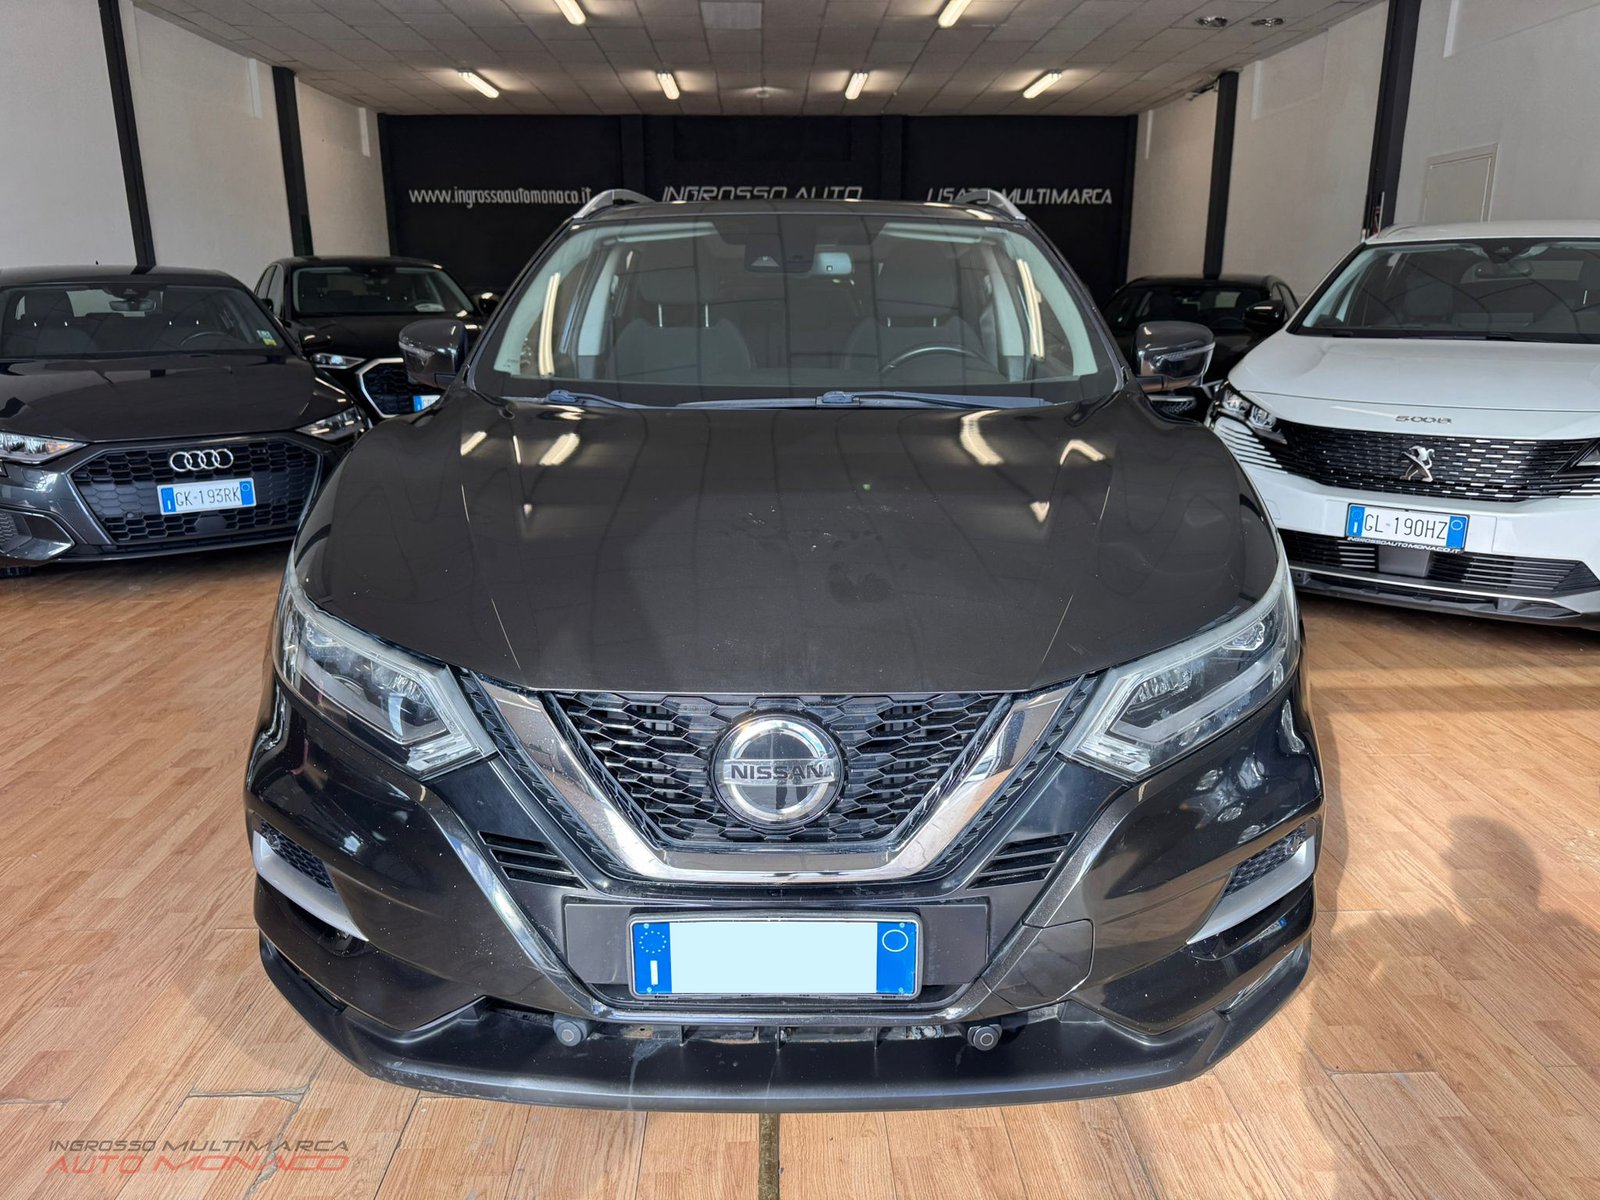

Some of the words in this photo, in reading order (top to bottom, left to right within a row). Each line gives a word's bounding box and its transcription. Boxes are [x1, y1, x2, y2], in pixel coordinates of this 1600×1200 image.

[409, 186, 592, 209] www.ingrossoautomonaco.it
[662, 186, 788, 202] INGROSSO
[796, 186, 863, 200] AUTO
[926, 187, 990, 204] USA
[998, 187, 1112, 205] MULTIMARCA
[175, 491, 193, 507] GK
[199, 486, 241, 505] 193RK
[1364, 513, 1384, 534] GL
[1394, 516, 1448, 540] 190HZ
[731, 764, 824, 780] NISSAN
